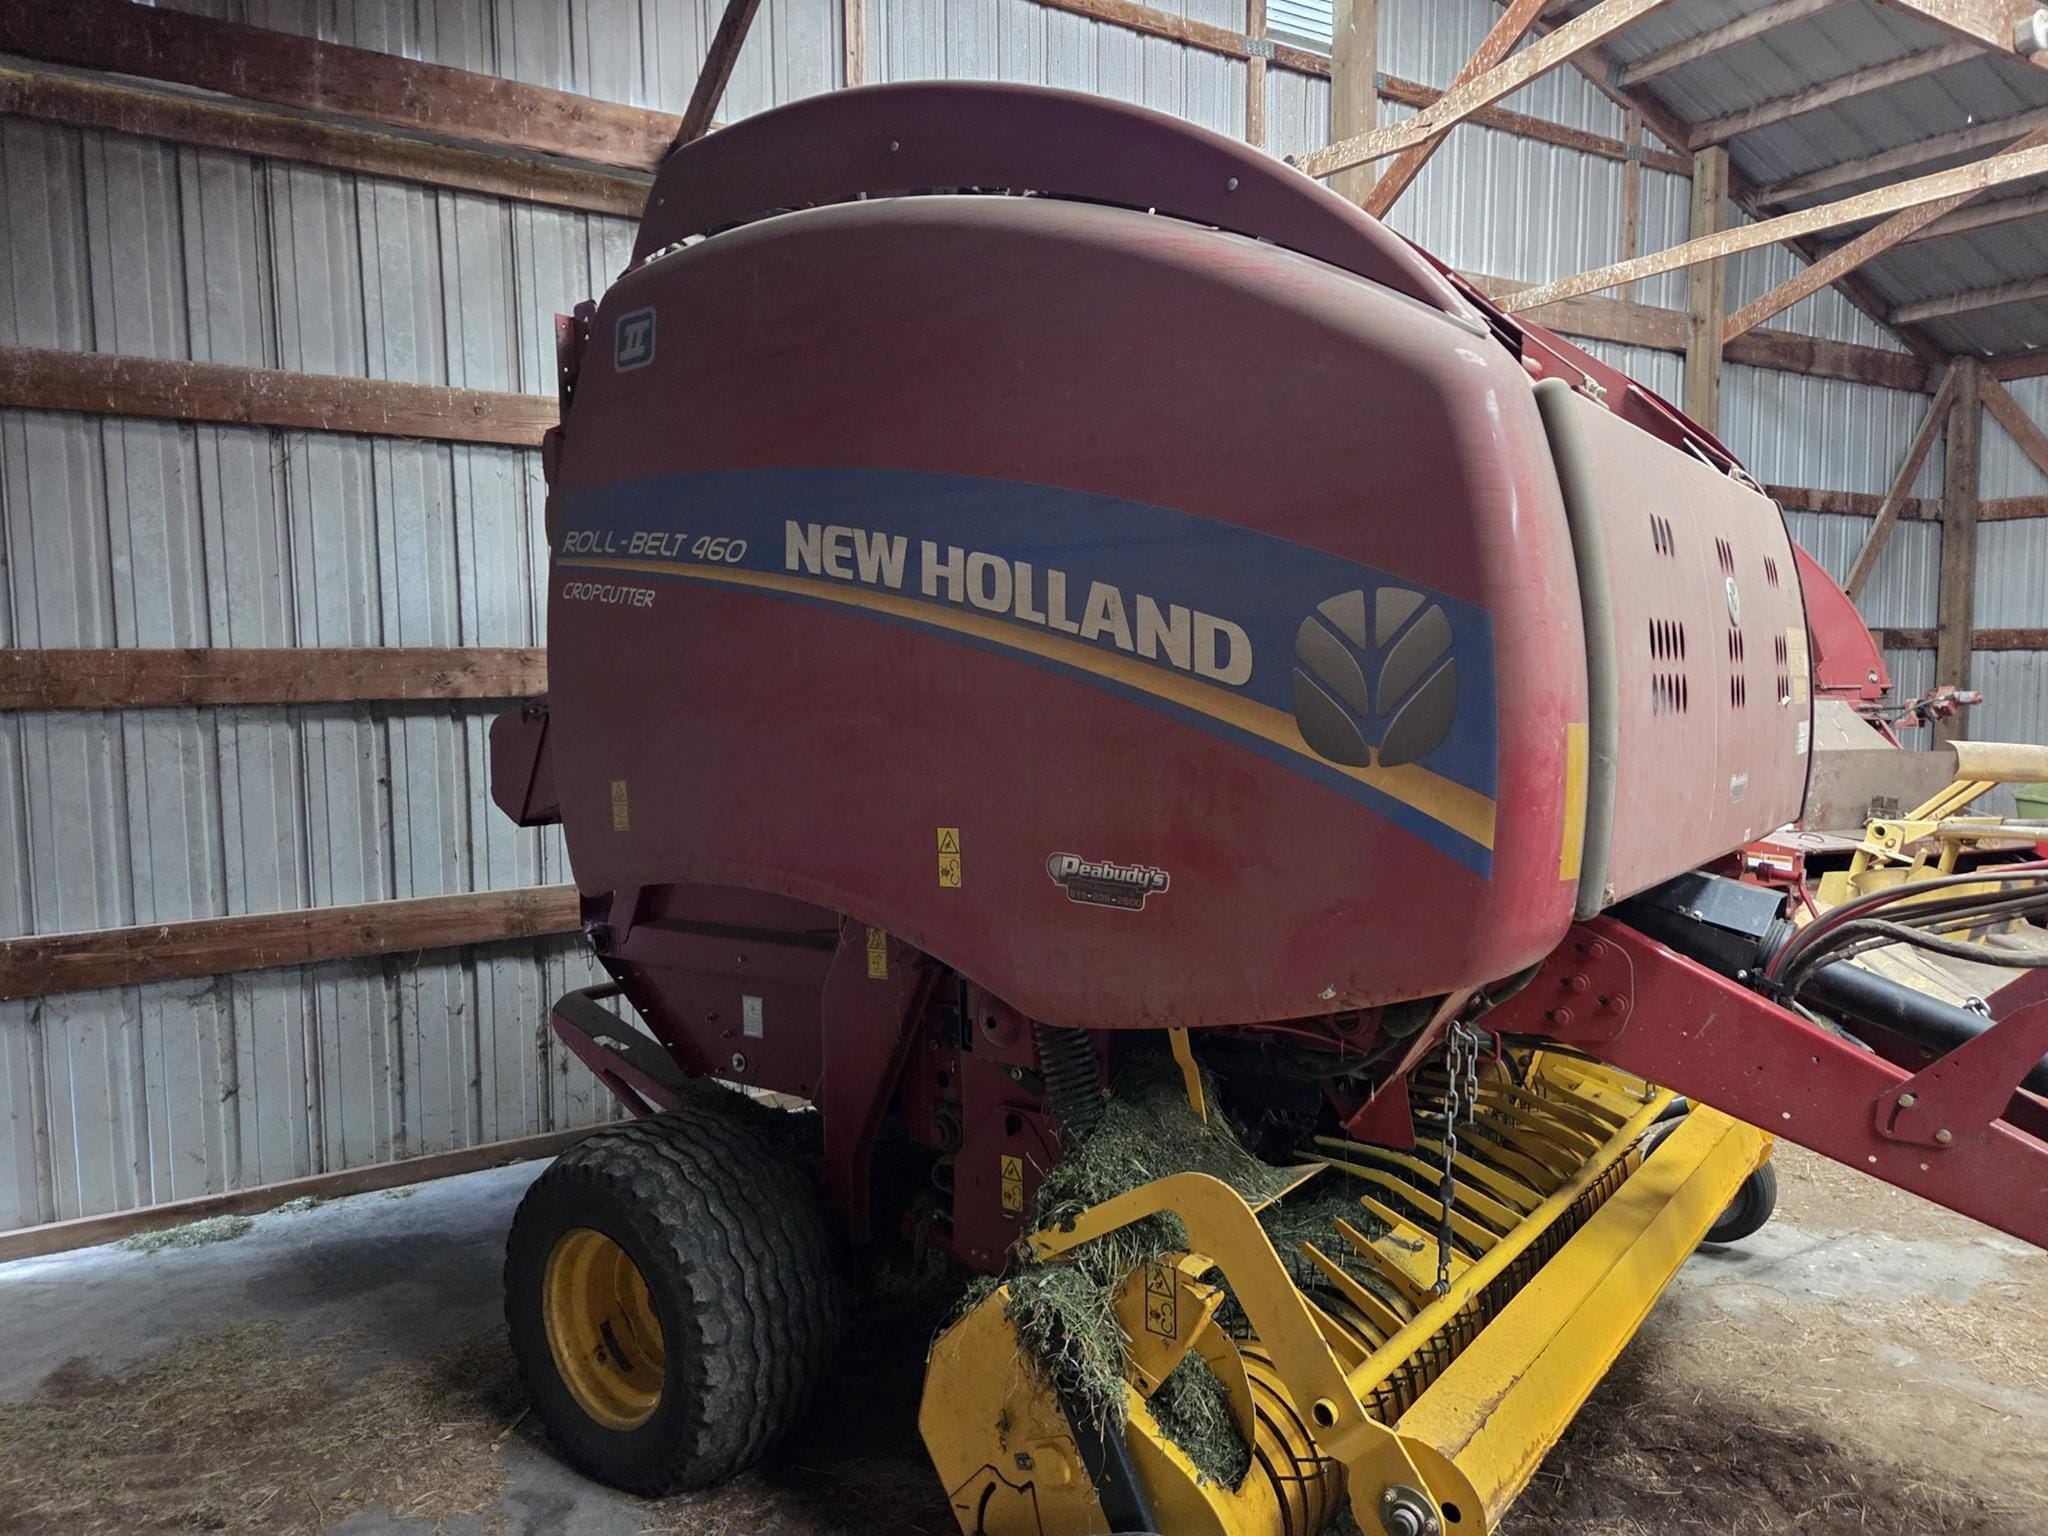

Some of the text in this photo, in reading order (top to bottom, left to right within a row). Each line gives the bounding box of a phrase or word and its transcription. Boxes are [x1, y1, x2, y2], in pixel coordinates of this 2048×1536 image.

[562, 530, 748, 563] ROLL-BELT 460
[562, 582, 656, 608] CROPCUTTER
[785, 519, 1253, 686] NEW HOLLAND
[1060, 856, 1165, 888] Peabudy's
